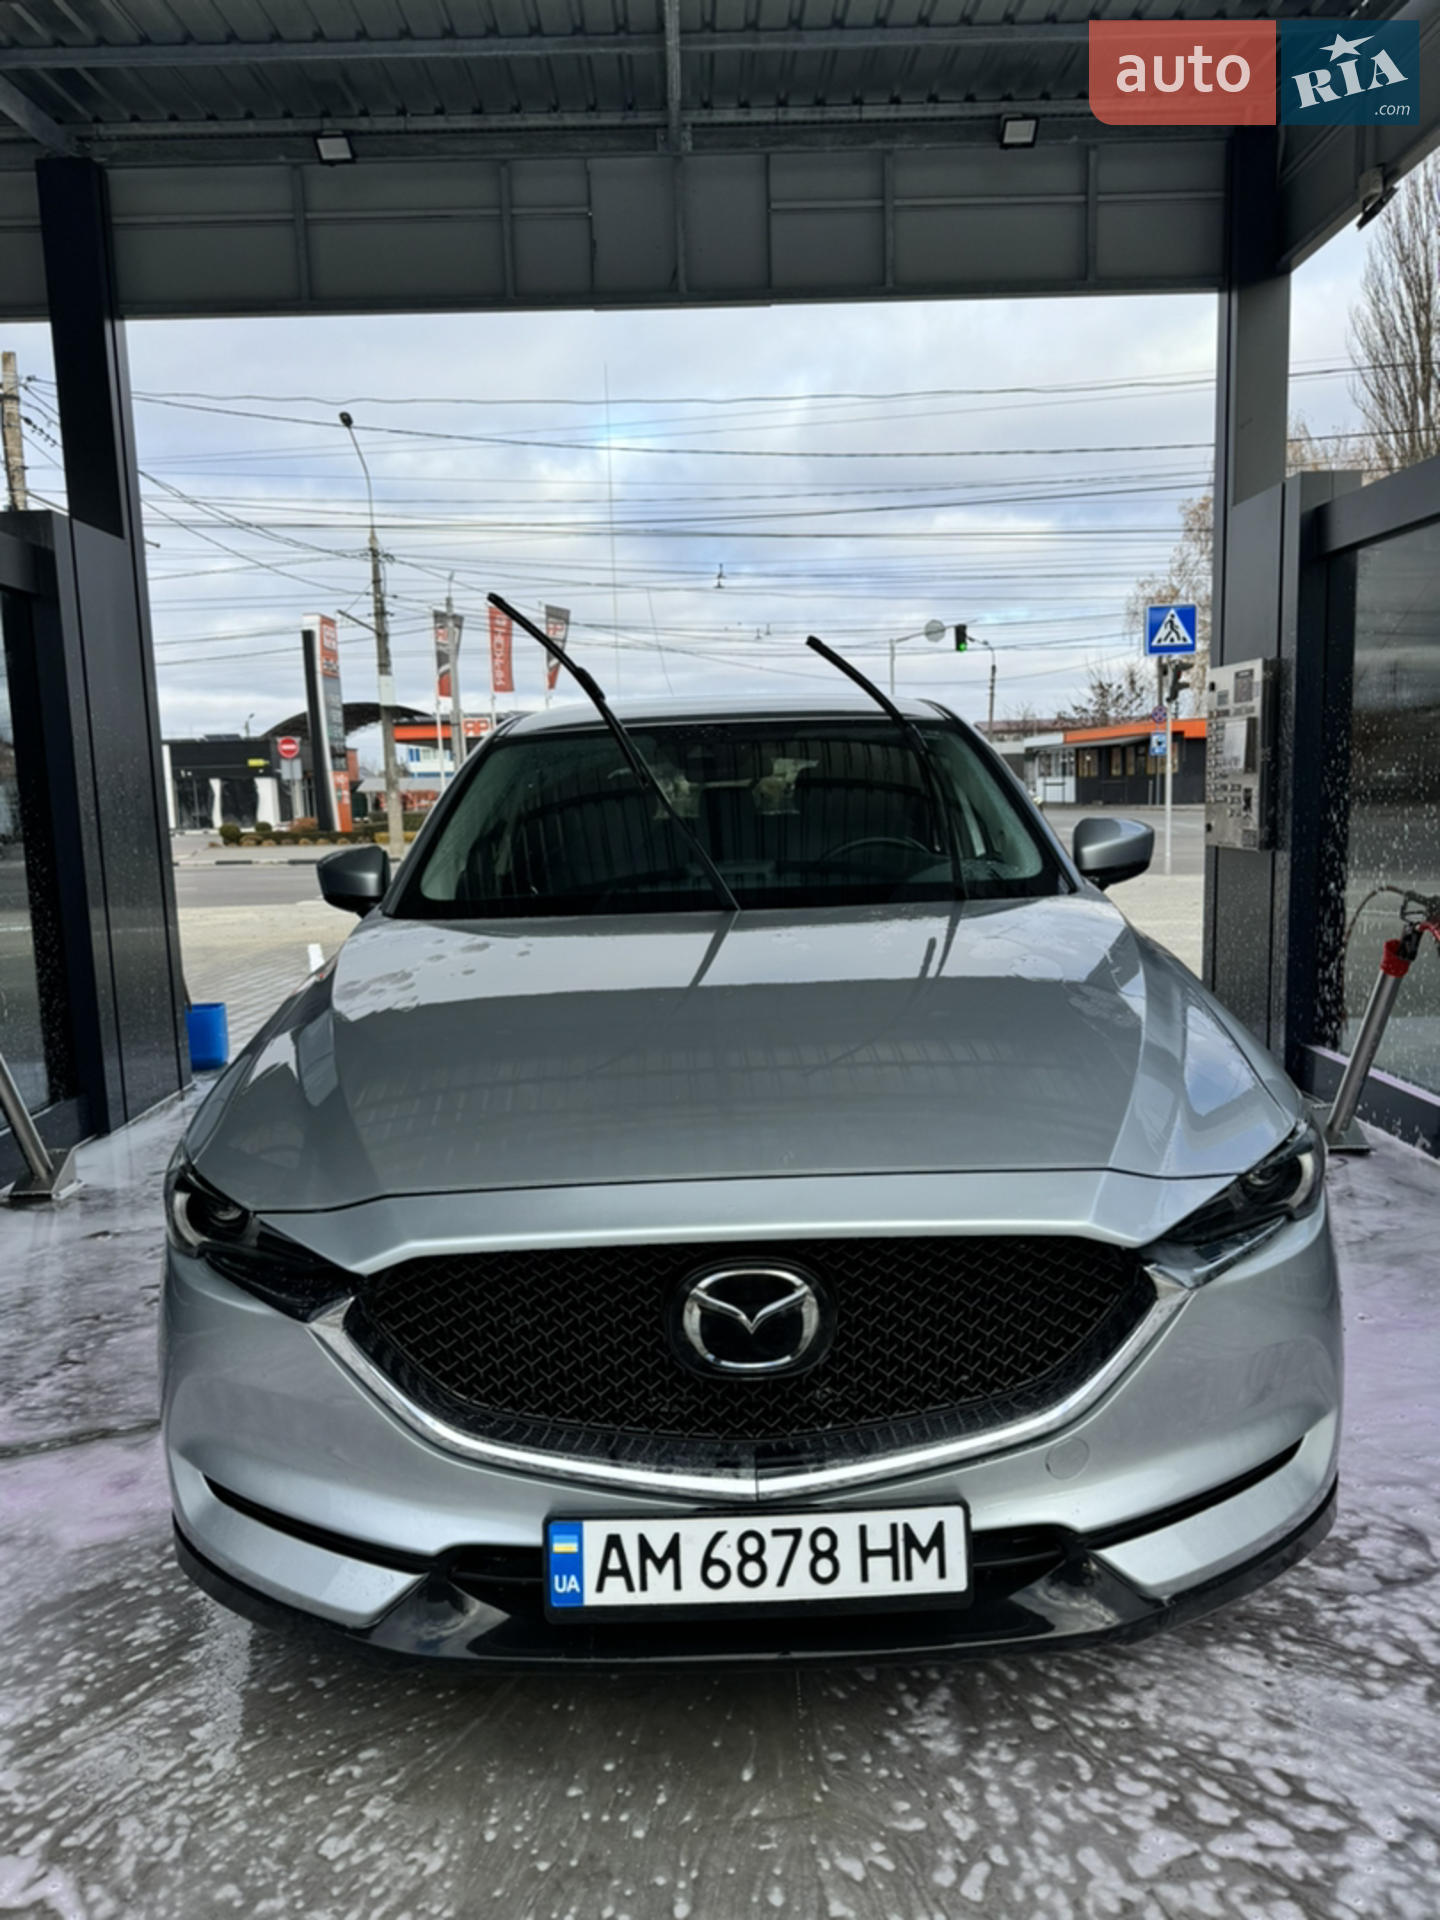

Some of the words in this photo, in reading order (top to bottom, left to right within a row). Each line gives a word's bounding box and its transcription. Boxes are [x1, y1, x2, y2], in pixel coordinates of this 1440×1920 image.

[595, 1531, 682, 1593] AM
[700, 1526, 840, 1590] 6878
[858, 1520, 947, 1583] HM
[554, 1574, 580, 1593] UA
